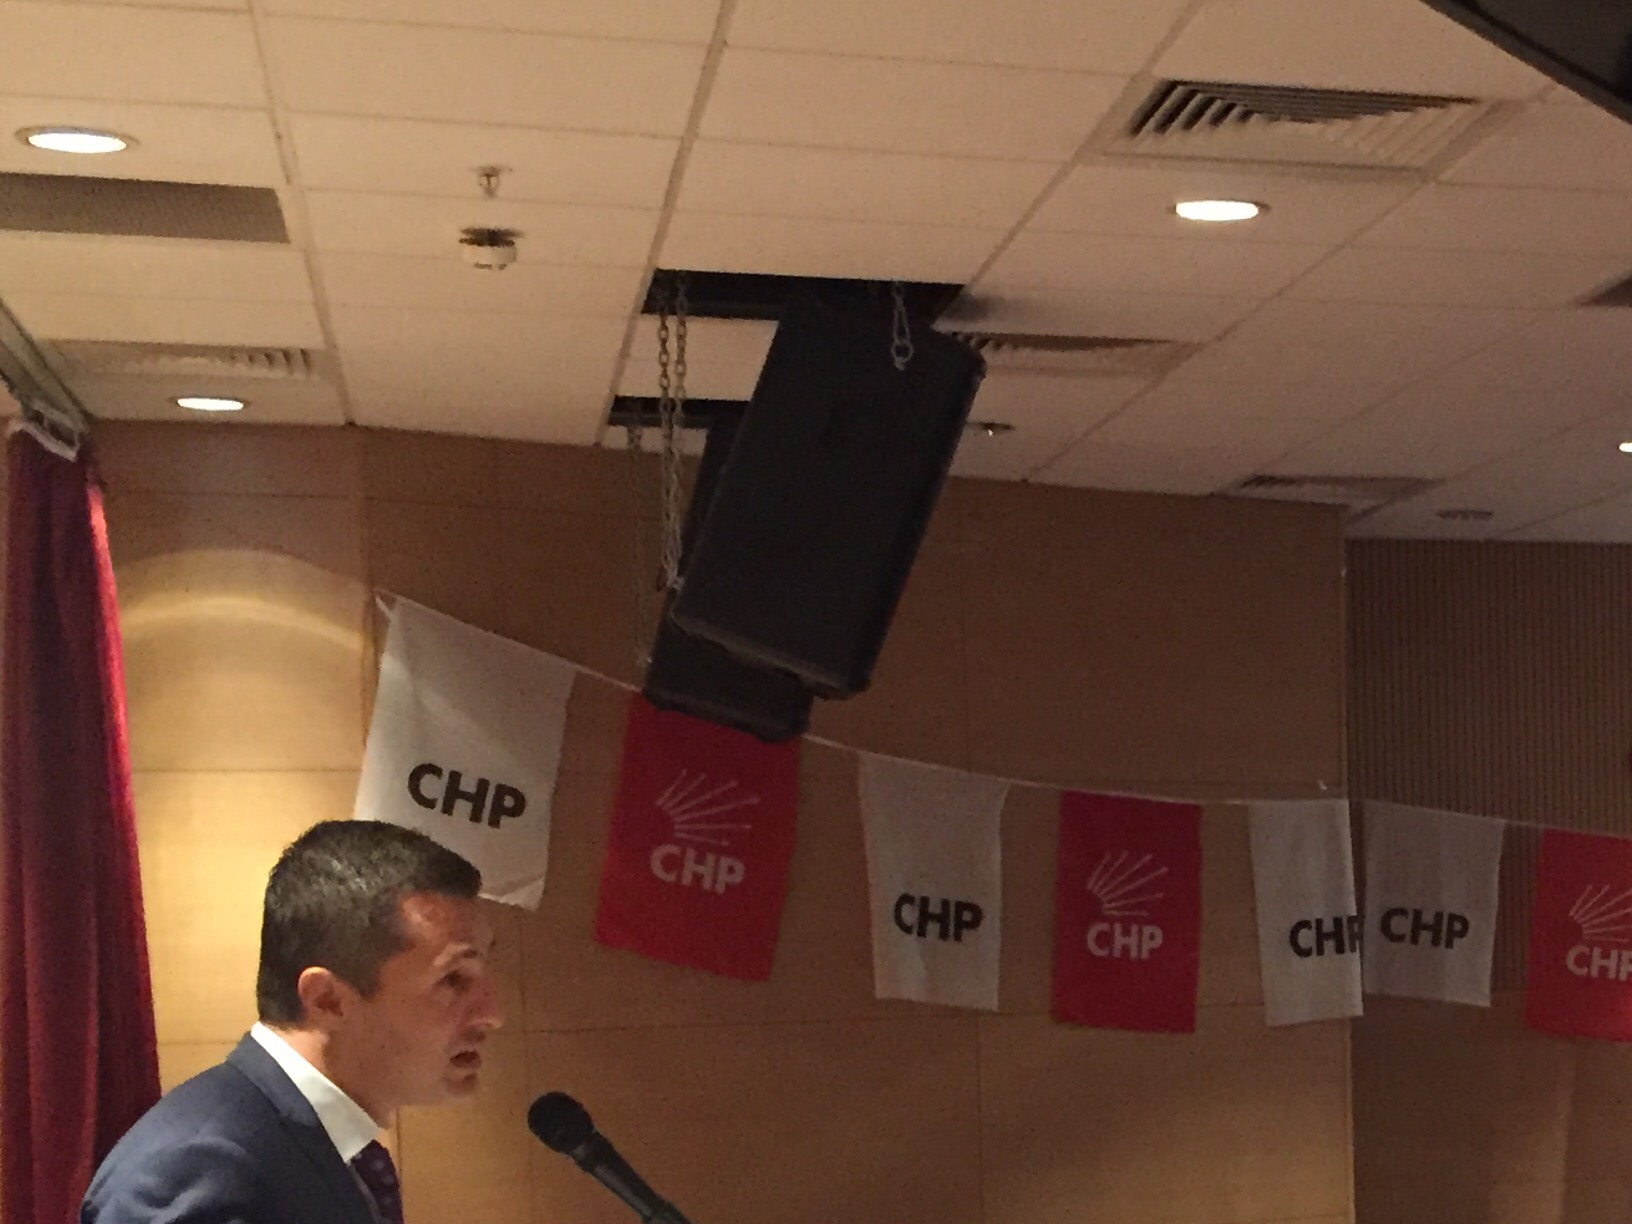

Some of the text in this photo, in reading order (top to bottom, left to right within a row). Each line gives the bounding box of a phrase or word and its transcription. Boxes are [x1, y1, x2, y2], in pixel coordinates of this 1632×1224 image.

[407, 762, 529, 830] CHP
[649, 843, 746, 895] CHP
[893, 892, 985, 944] CHP
[1086, 922, 1165, 960] CHP
[1379, 906, 1470, 950] CHP
